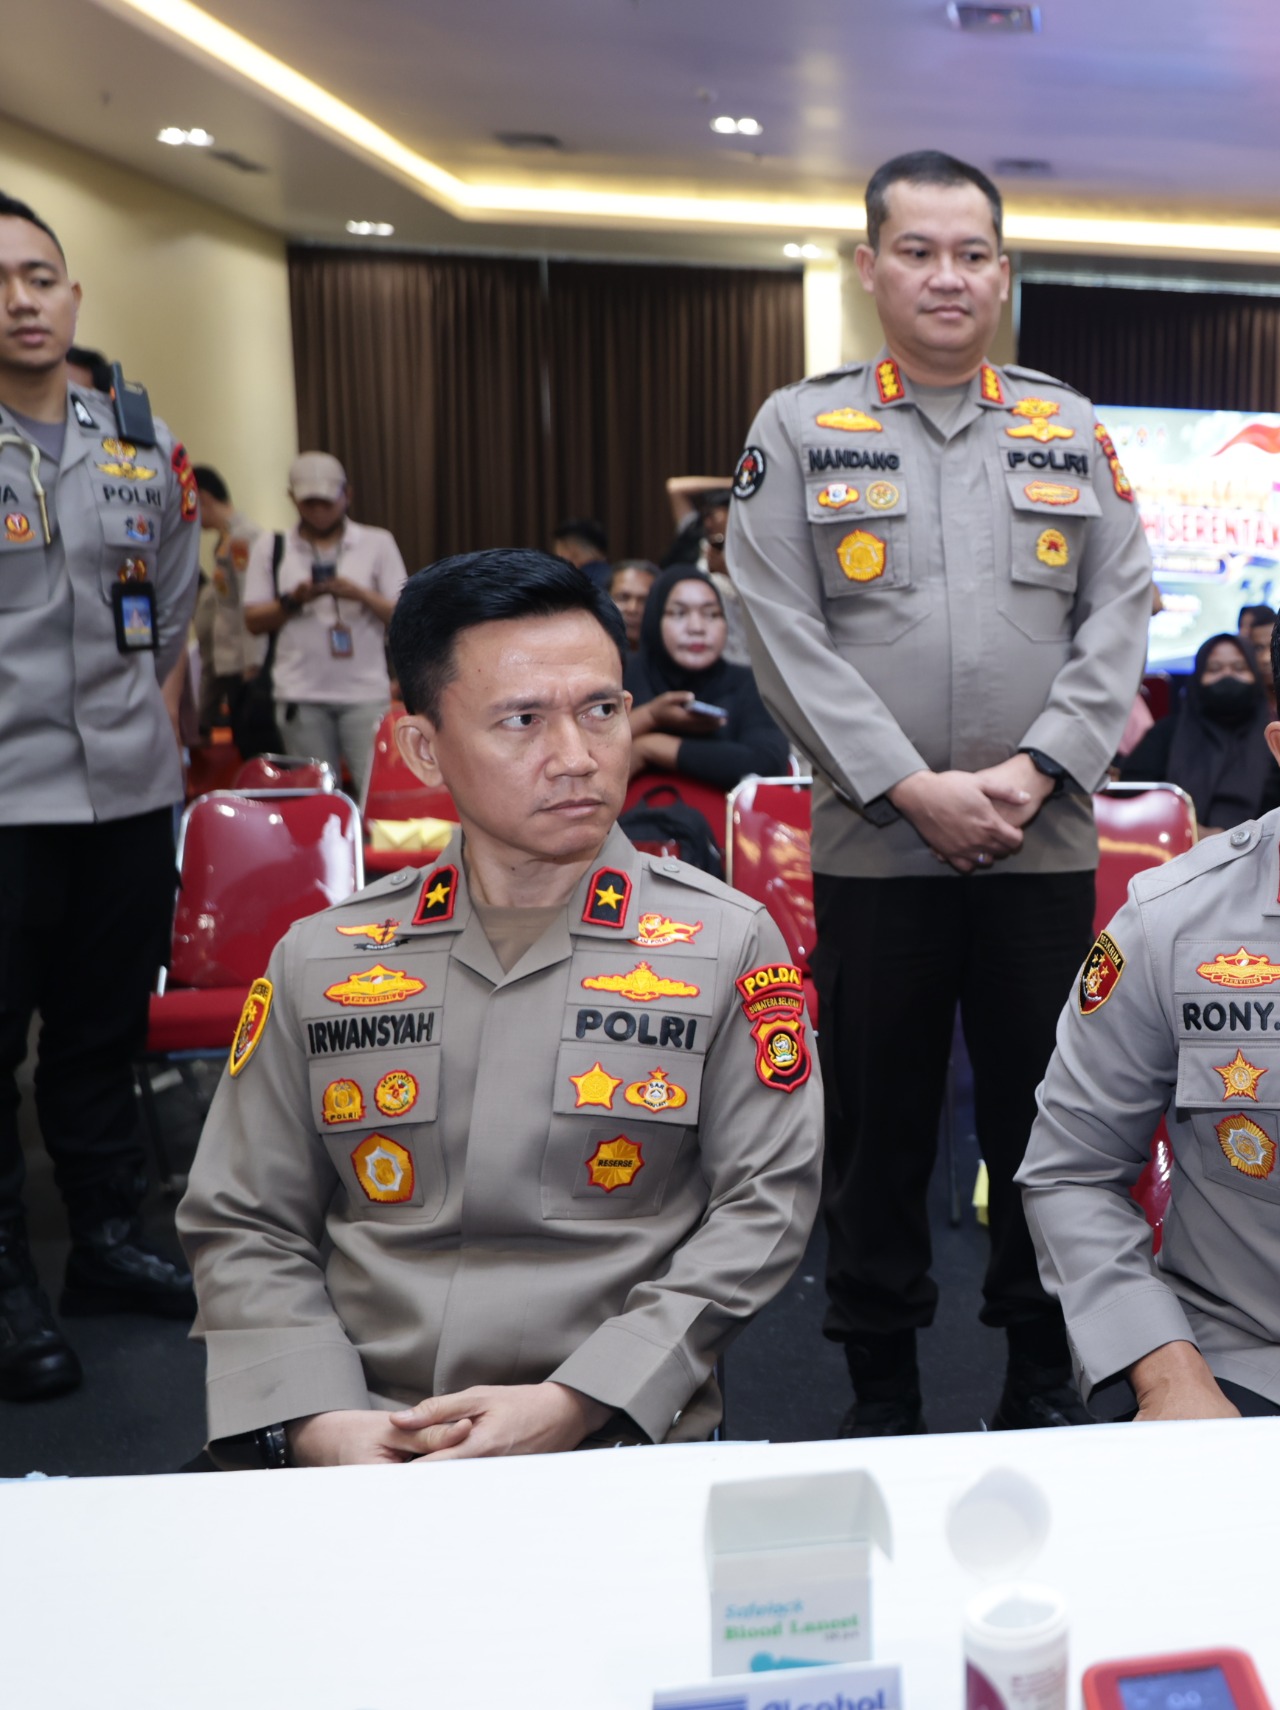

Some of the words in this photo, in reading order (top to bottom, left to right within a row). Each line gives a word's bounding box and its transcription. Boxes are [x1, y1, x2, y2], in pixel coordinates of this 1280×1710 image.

[808, 446, 900, 472] NANDANG
[1007, 449, 1089, 476] POLRI
[102, 484, 162, 508] POLRI
[744, 967, 800, 997] POLDA
[307, 1011, 435, 1055] IRWANSYAH
[575, 1008, 697, 1050] POLRI
[330, 1112, 358, 1121] POLRI
[597, 1159, 633, 1168] RESERSE
